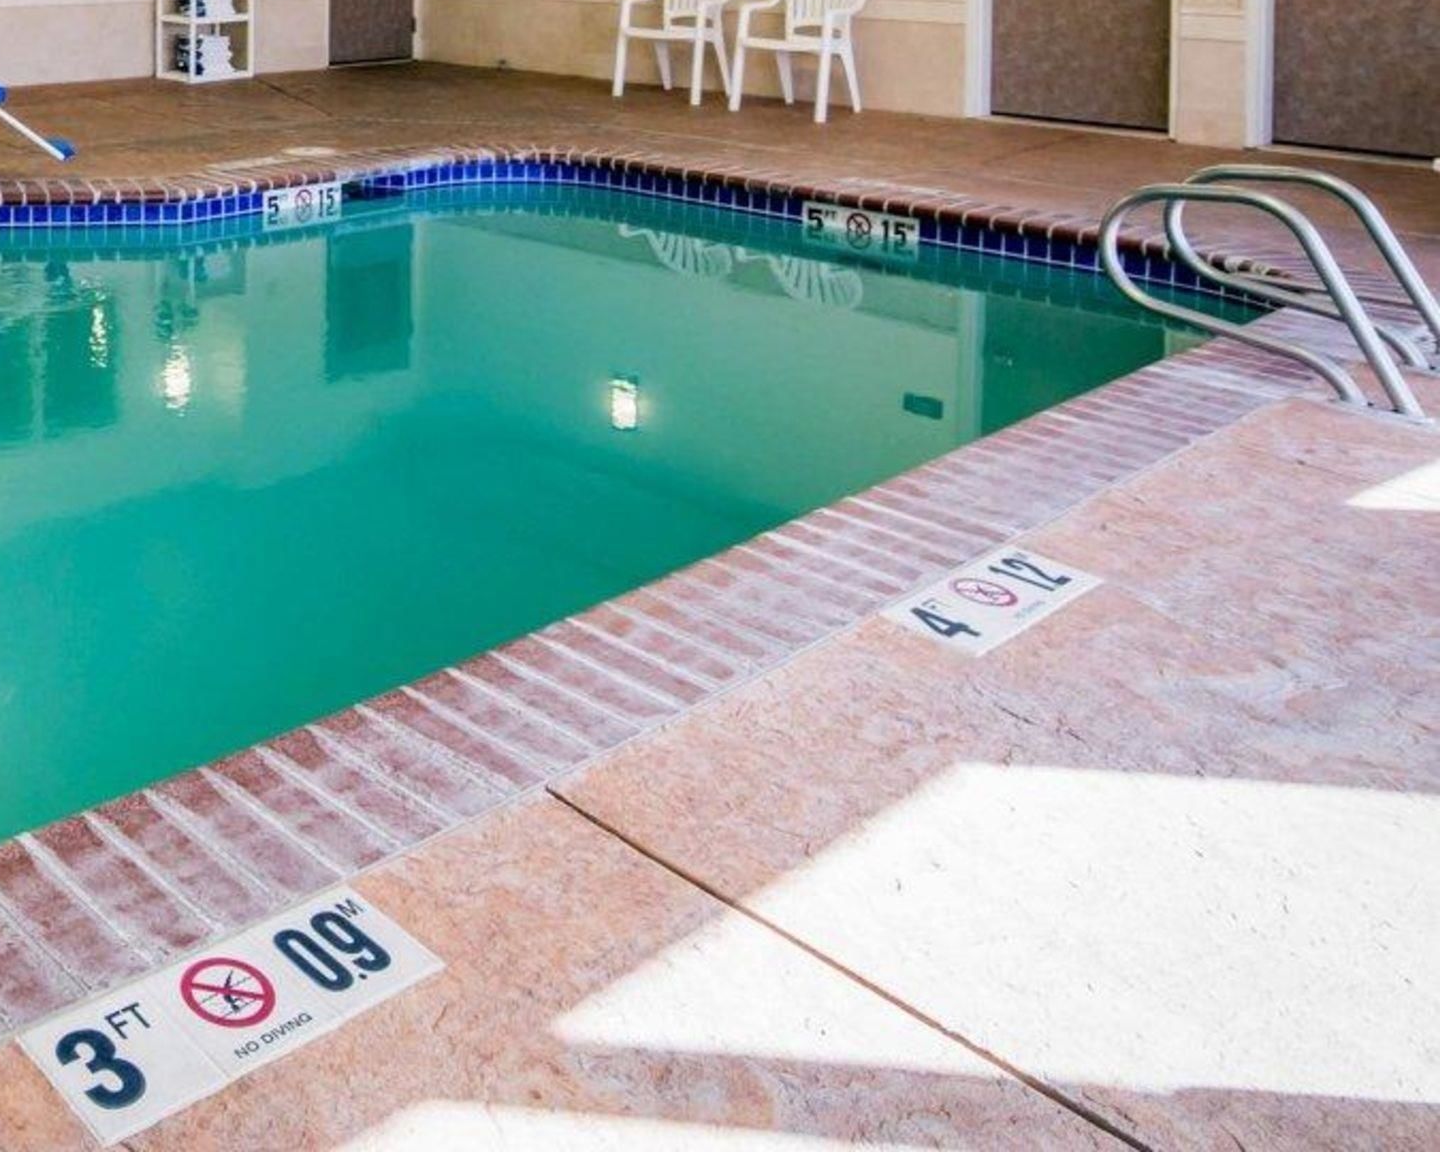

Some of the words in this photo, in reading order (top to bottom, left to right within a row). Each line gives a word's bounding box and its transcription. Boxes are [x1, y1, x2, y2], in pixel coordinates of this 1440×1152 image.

[807, 208, 824, 229] 5
[910, 607, 981, 637] 4
[55, 1028, 147, 1110] 3
[104, 1002, 151, 1040] FT
[334, 898, 364, 918] M
[234, 1040, 260, 1059] NO
[260, 1012, 313, 1045] DIVING
